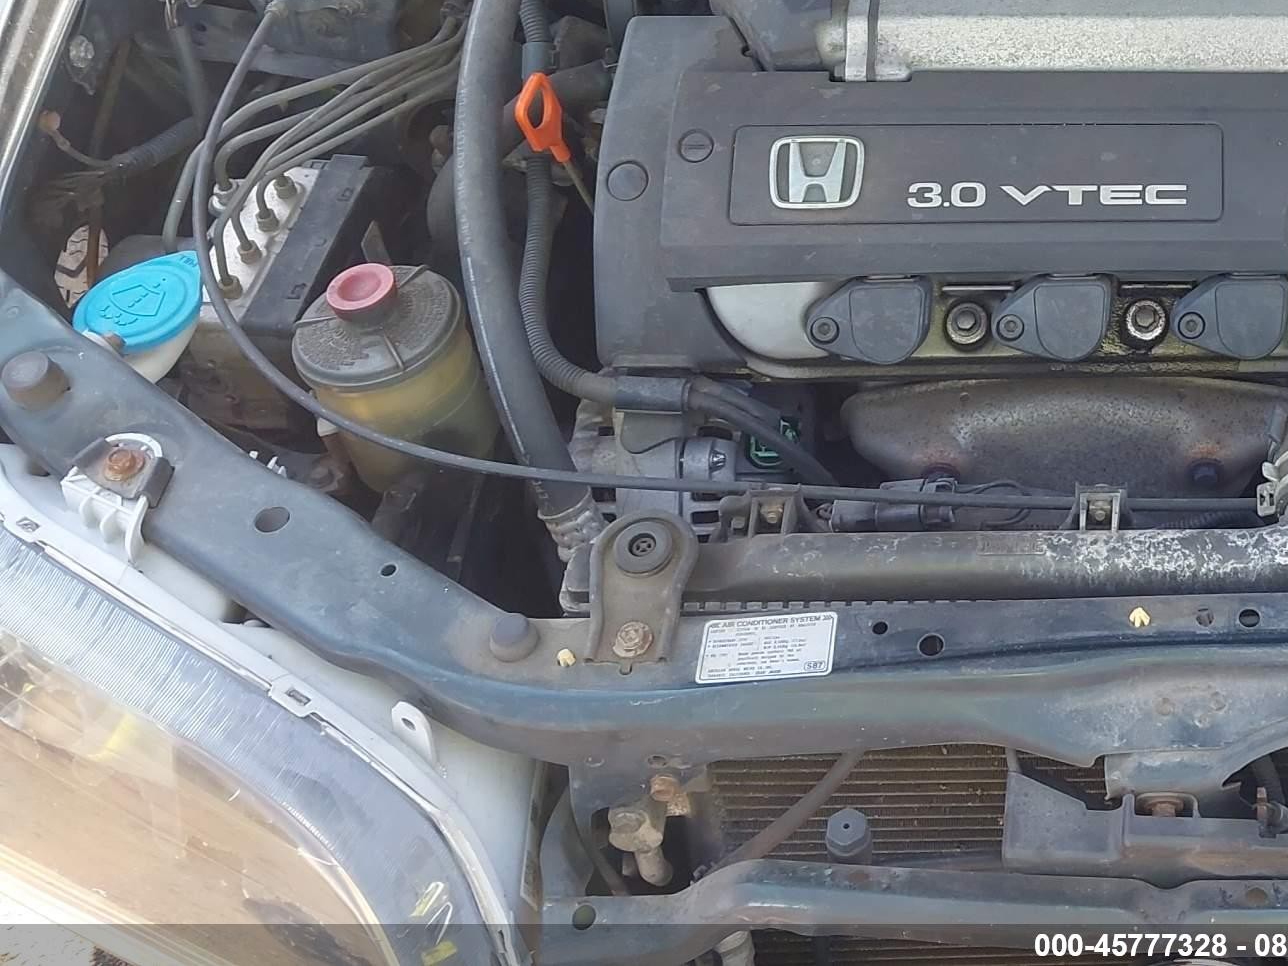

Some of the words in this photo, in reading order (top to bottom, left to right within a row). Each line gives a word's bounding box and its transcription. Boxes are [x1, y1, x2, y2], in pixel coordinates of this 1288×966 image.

[907, 182, 987, 208] 3.0
[999, 184, 1188, 206] VTEC
[736, 617, 789, 628] CONDITIONER
[790, 615, 821, 624] SYSTEM
